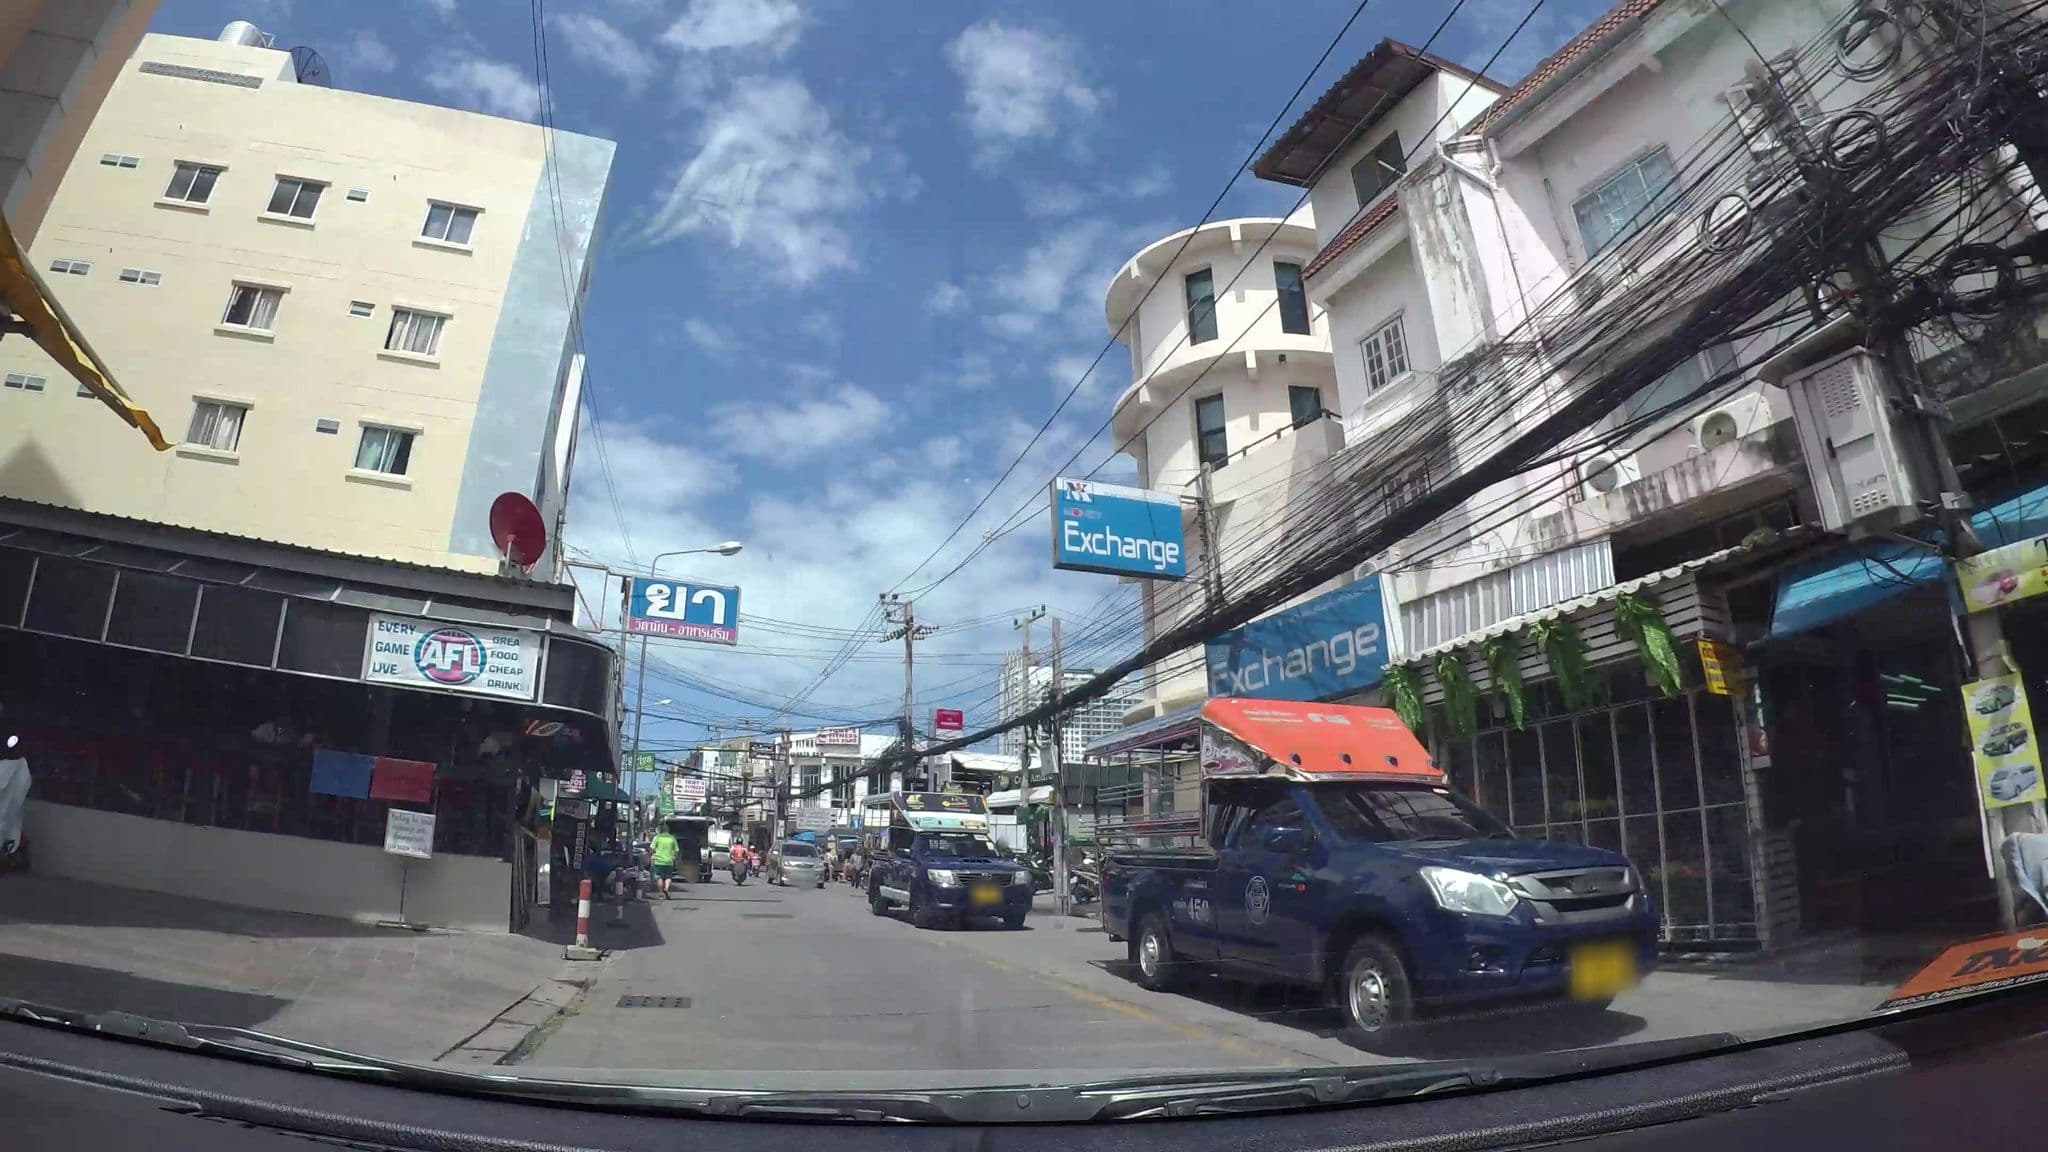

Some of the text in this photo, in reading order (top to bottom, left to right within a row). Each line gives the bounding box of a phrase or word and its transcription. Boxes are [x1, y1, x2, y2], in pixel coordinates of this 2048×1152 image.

[1064, 519, 1180, 570] Exchange
[645, 583, 726, 625] ยา
[378, 620, 417, 635] EVERY
[375, 641, 411, 656] GAME
[490, 650, 519, 661] FOOD
[418, 639, 482, 674] AFL
[1211, 621, 1380, 698] Exchange
[372, 661, 398, 675] LIVE
[488, 664, 524, 676] CHEAP
